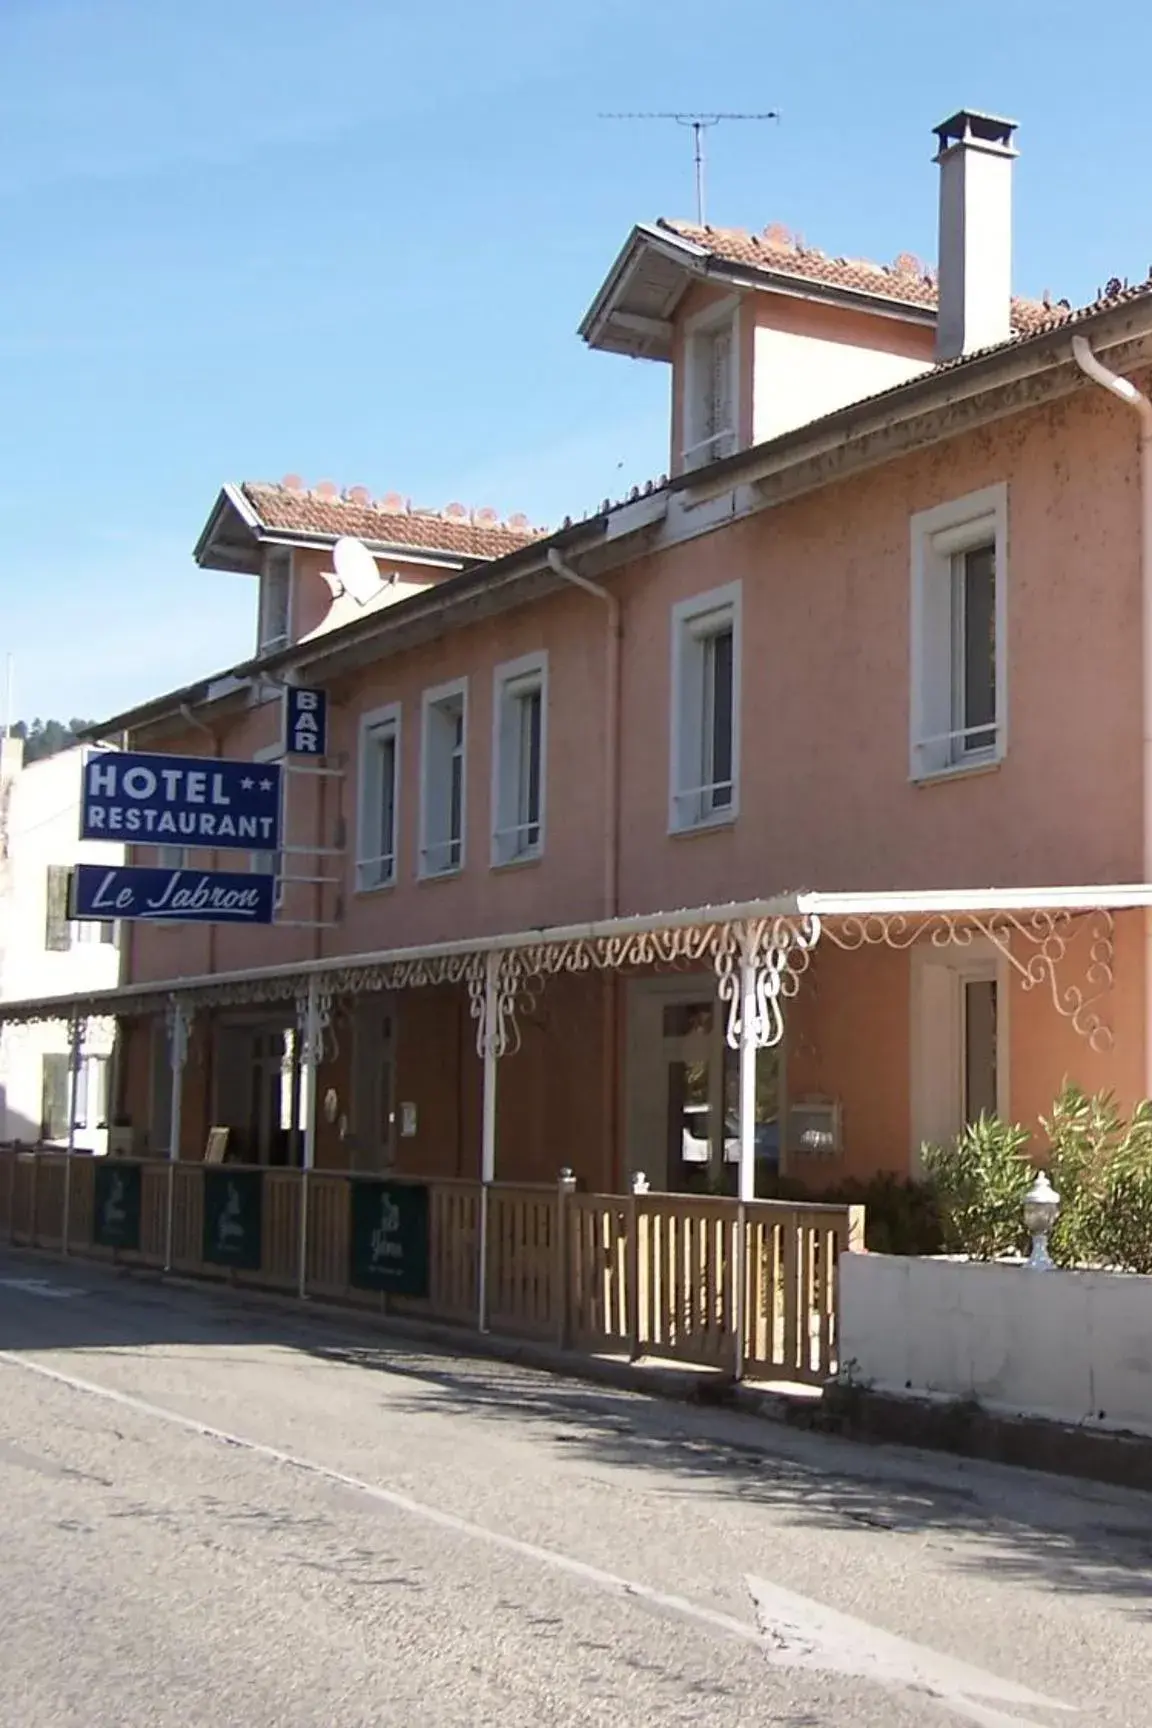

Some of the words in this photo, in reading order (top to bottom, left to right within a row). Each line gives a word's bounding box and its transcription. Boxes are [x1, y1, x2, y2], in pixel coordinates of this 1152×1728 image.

[294, 690, 319, 751] BAR
[88, 763, 231, 805] HOTEL
[88, 804, 274, 839] RESTAURANT
[91, 871, 135, 909] Le
[145, 871, 261, 909] Jabron
